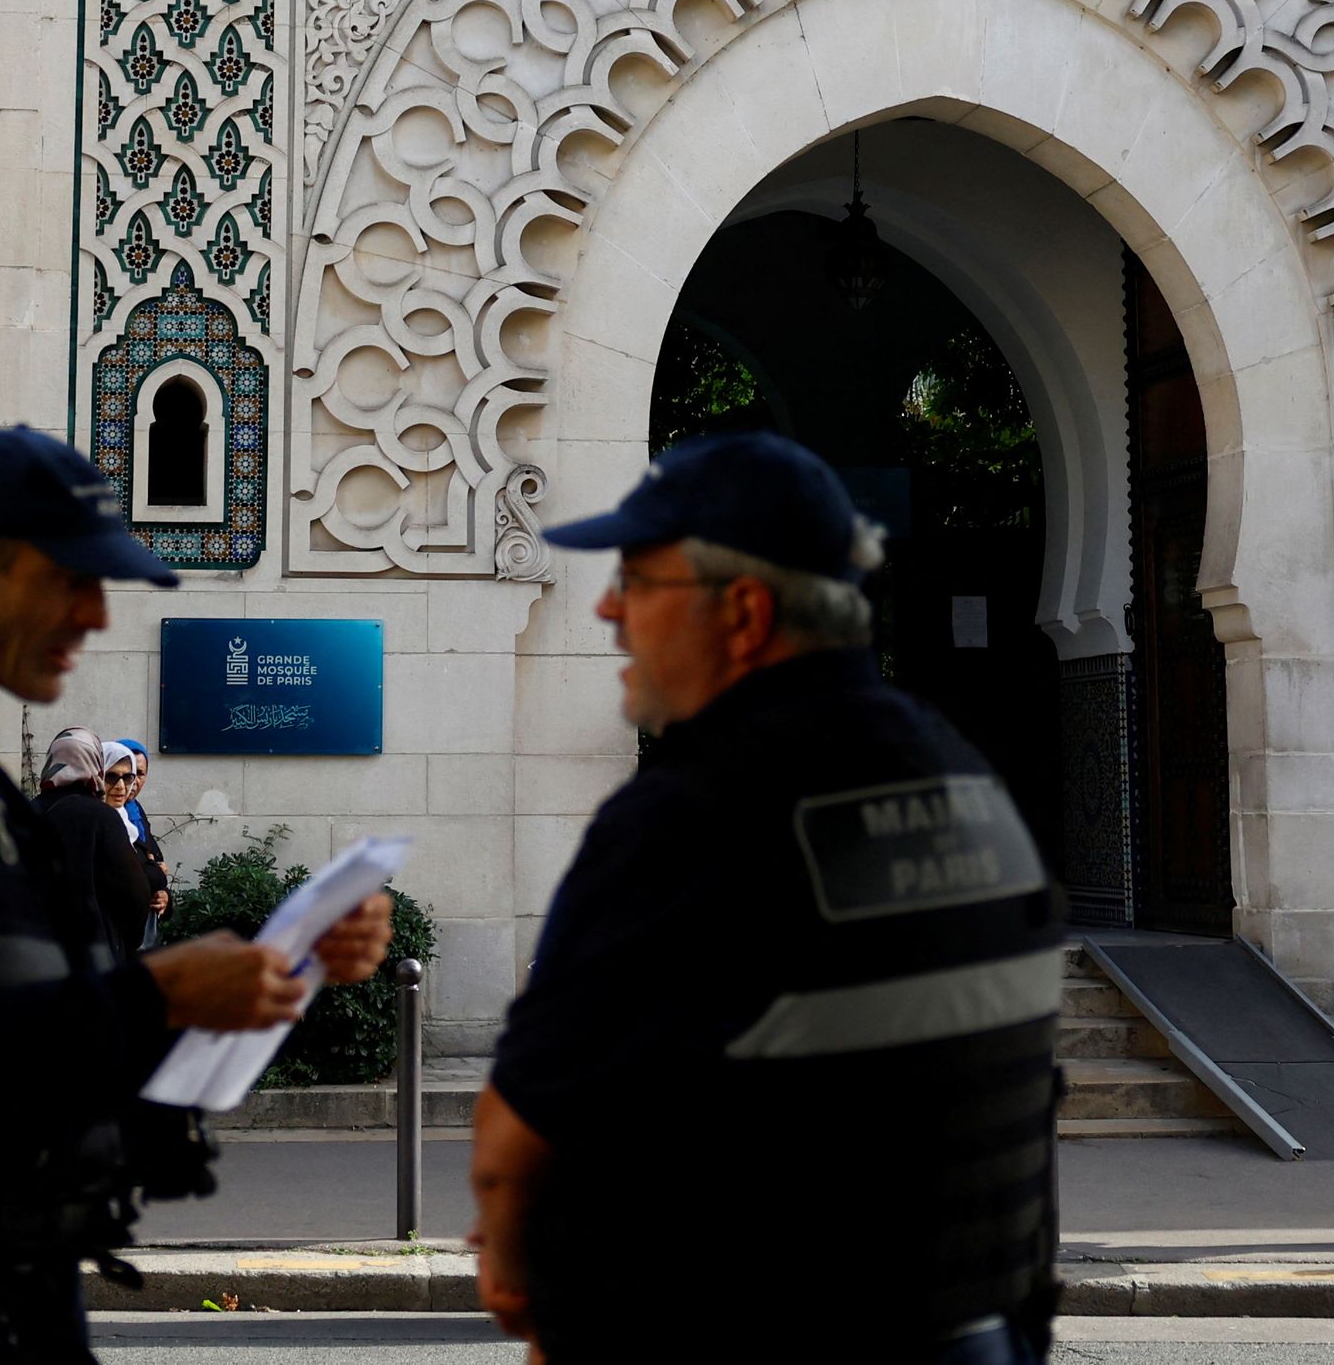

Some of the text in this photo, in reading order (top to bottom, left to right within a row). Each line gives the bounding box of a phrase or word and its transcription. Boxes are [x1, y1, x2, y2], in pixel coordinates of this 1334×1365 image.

[257, 655, 310, 664] GRANDE
[257, 663, 317, 676] MOSQUÉE
[257, 677, 312, 685] DE PARIS
